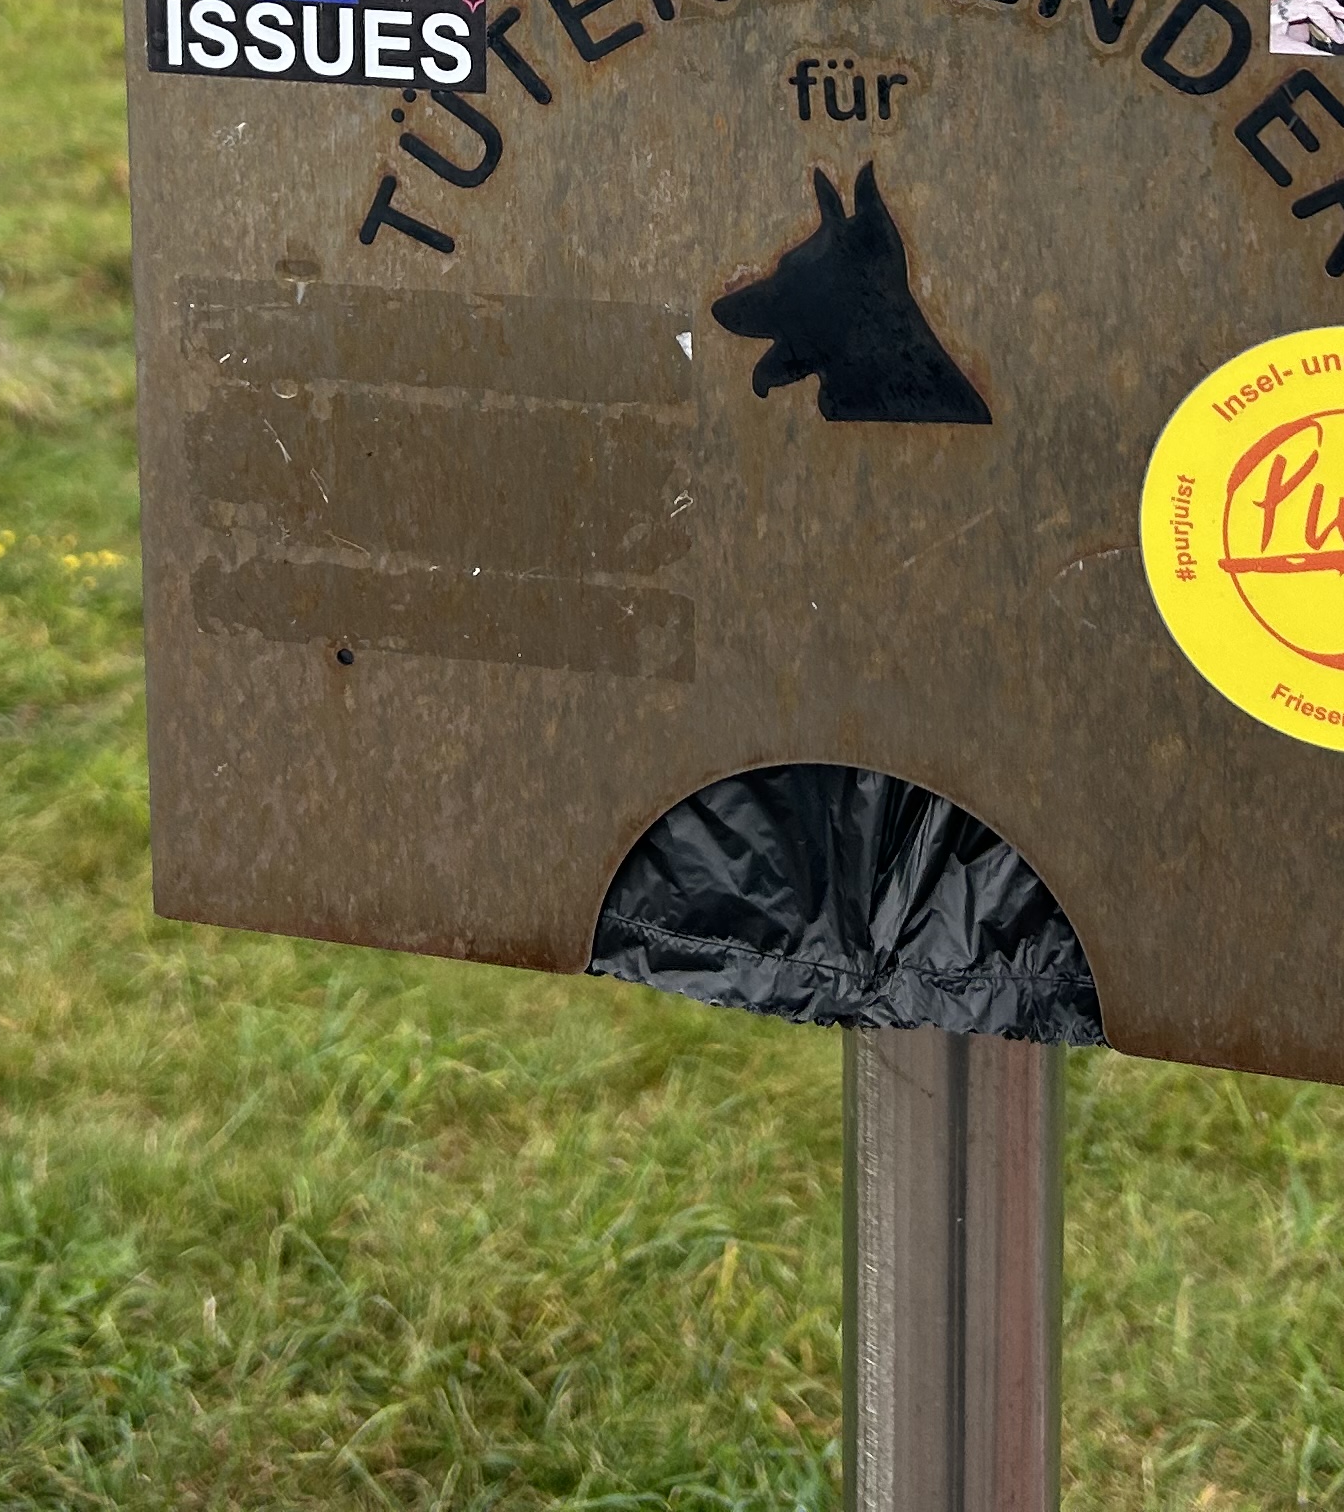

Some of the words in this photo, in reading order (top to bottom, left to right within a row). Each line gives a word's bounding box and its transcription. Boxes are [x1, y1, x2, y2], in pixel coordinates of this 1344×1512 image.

[789, 59, 909, 122] für
[1211, 363, 1293, 423] Insel-
[1169, 474, 1198, 582] #purjuist
